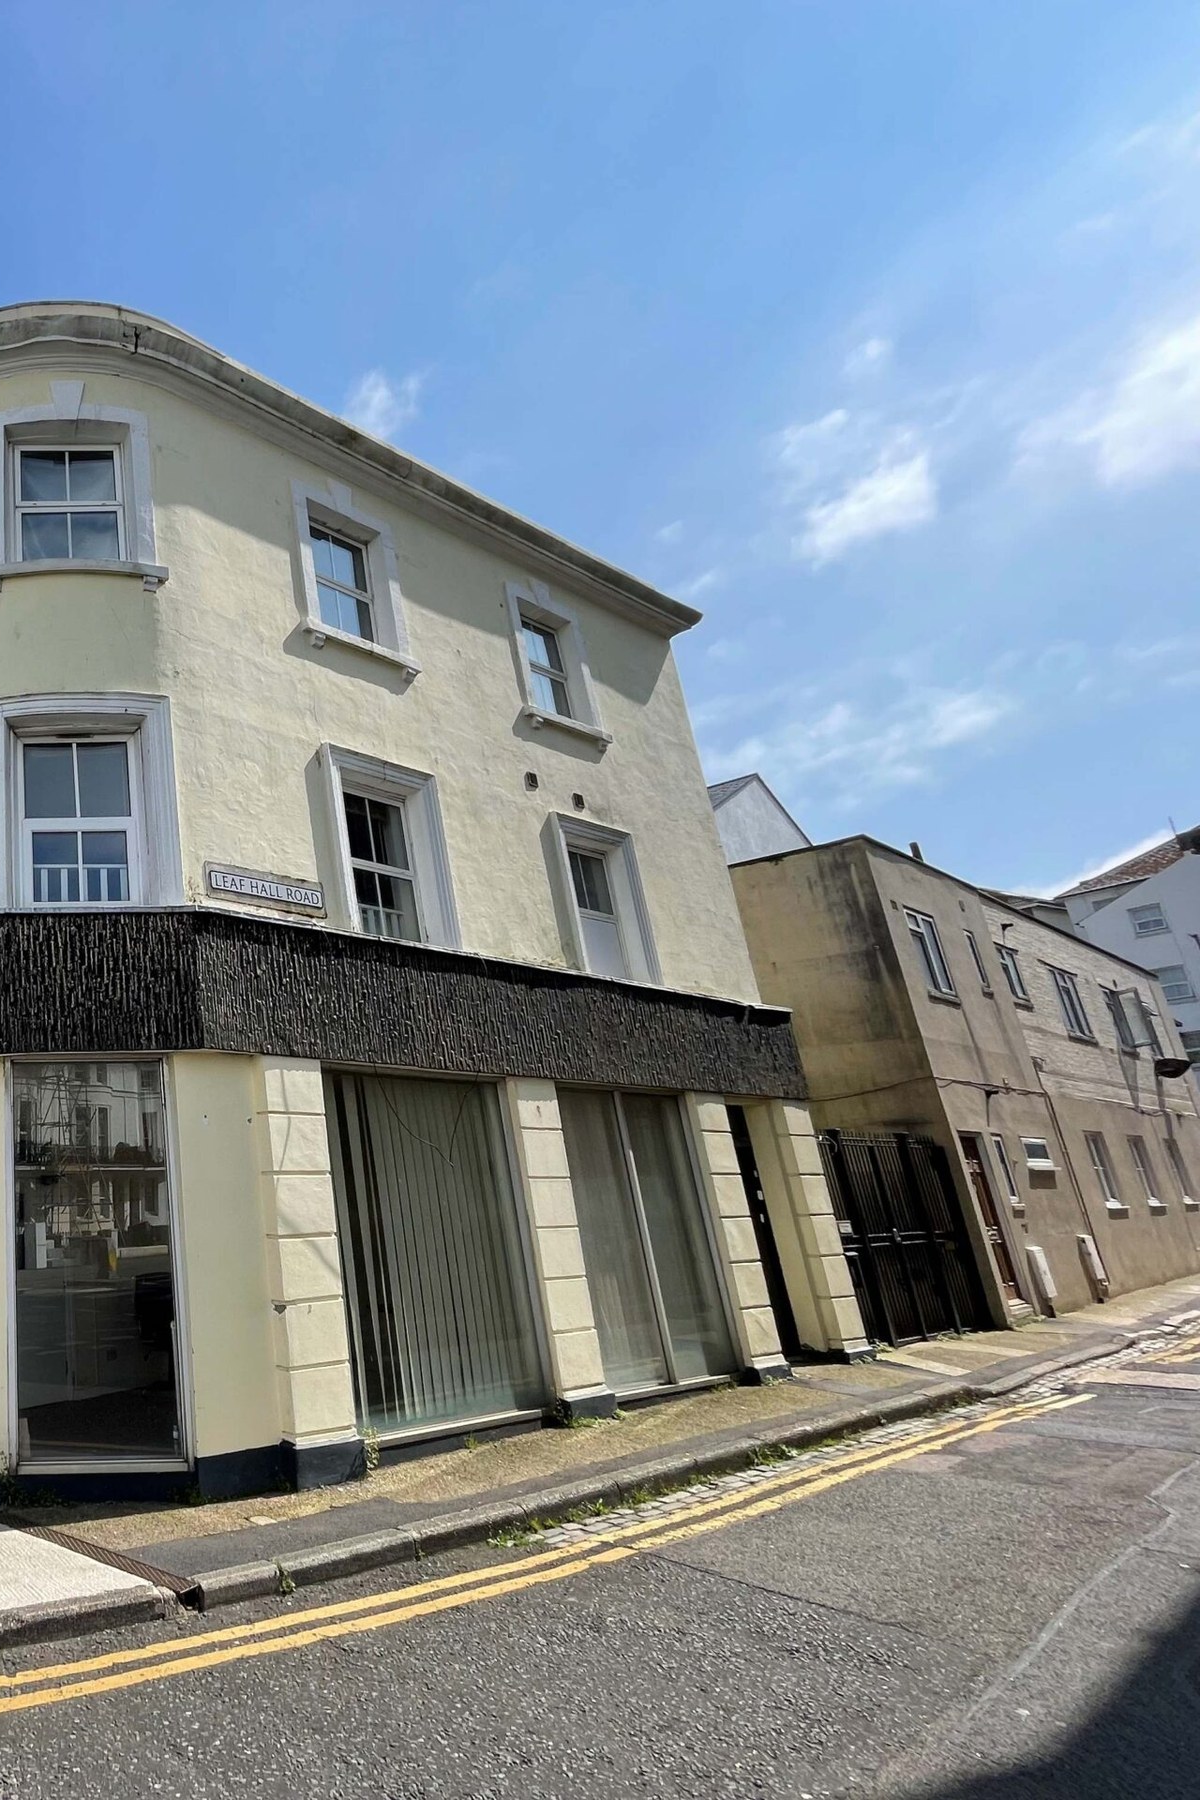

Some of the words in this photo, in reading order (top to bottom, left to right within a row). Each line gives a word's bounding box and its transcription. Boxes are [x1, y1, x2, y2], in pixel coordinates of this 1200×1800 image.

[215, 874, 245, 891] LEAF
[250, 881, 283, 898] HALL
[286, 889, 320, 905] ROAD
